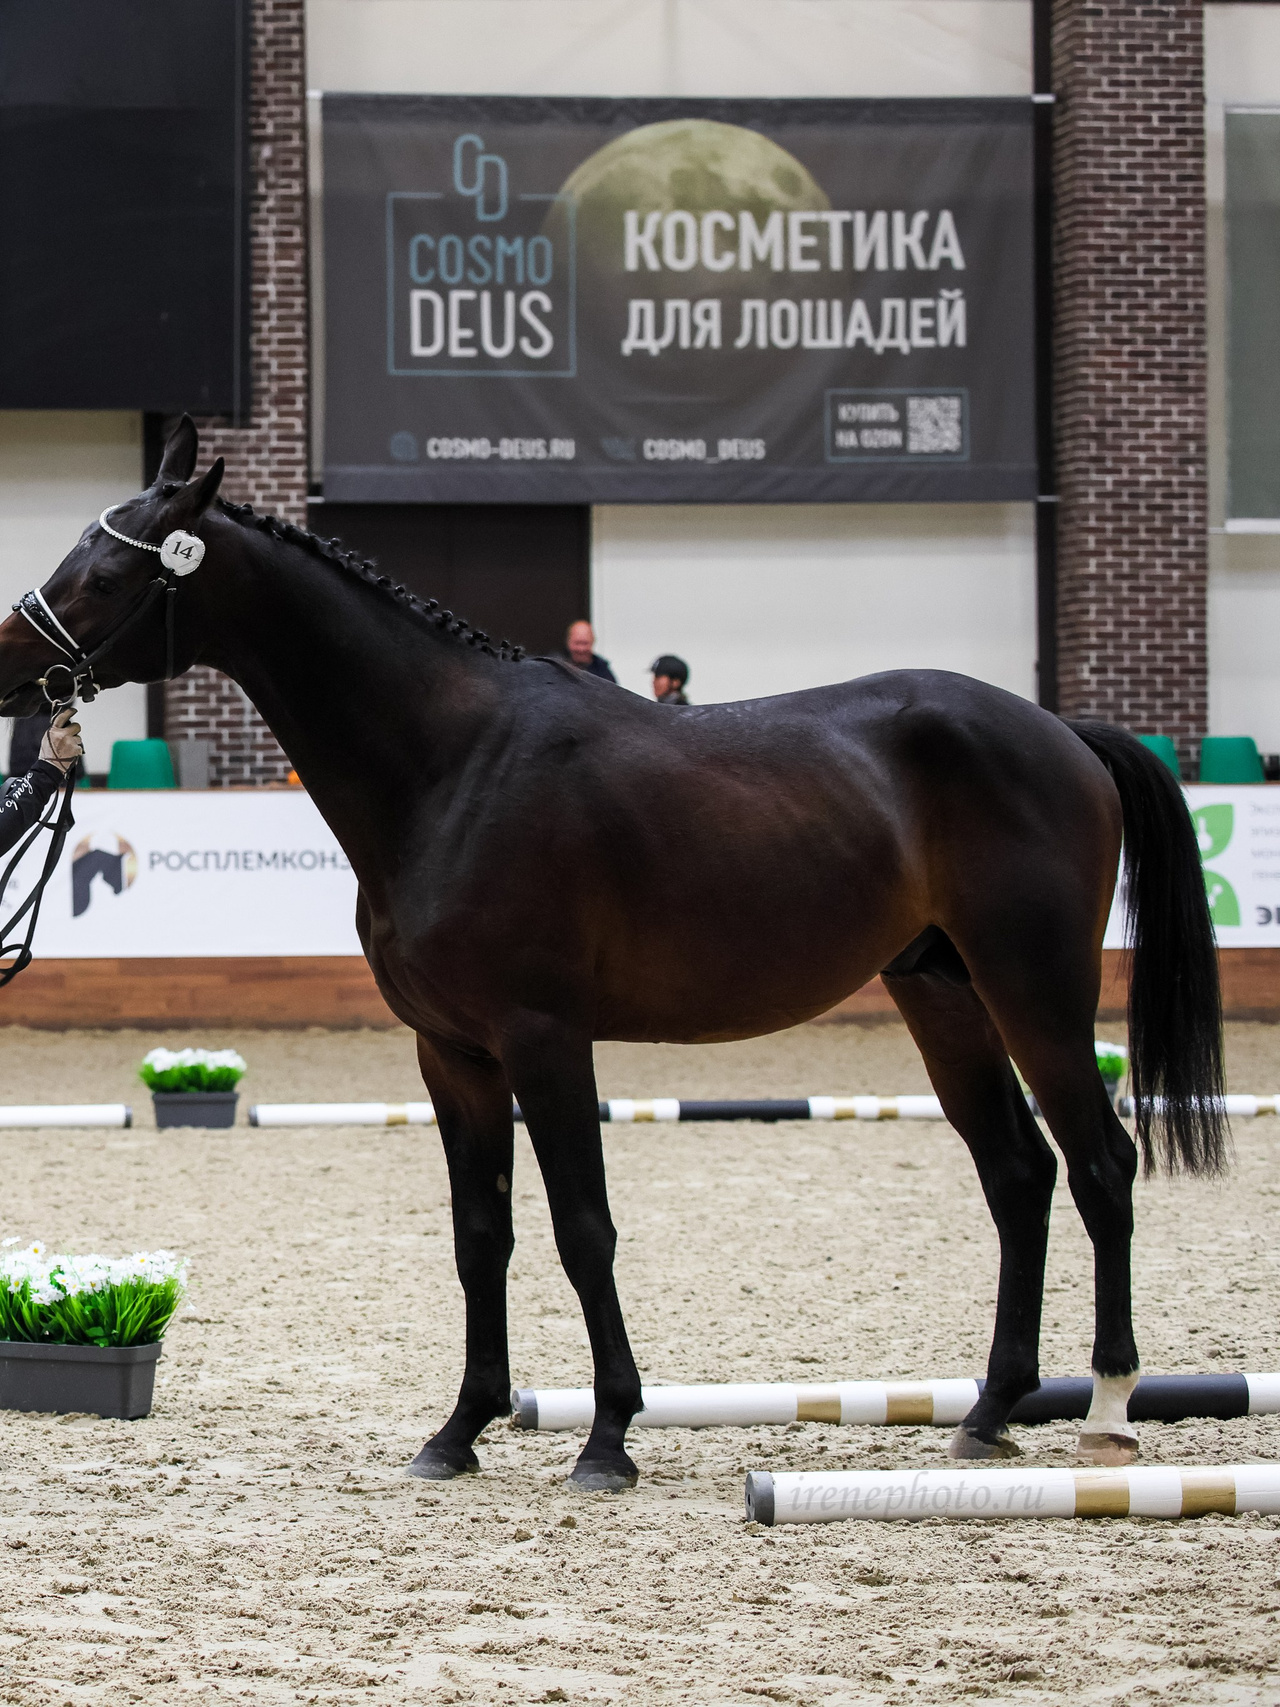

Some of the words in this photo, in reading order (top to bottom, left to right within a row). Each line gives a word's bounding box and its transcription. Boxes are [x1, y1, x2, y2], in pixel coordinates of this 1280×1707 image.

[409, 233, 554, 286] COSMO
[624, 209, 966, 272] КОСМЕТИКА
[409, 289, 554, 359] DEUS
[621, 299, 721, 356] ДЛЯ
[734, 288, 967, 355] ЛОШАДЕЙ
[426, 437, 576, 461] COSMO-DEUS.RU
[643, 438, 766, 465] COSMO_DEUS
[171, 540, 196, 560] 14
